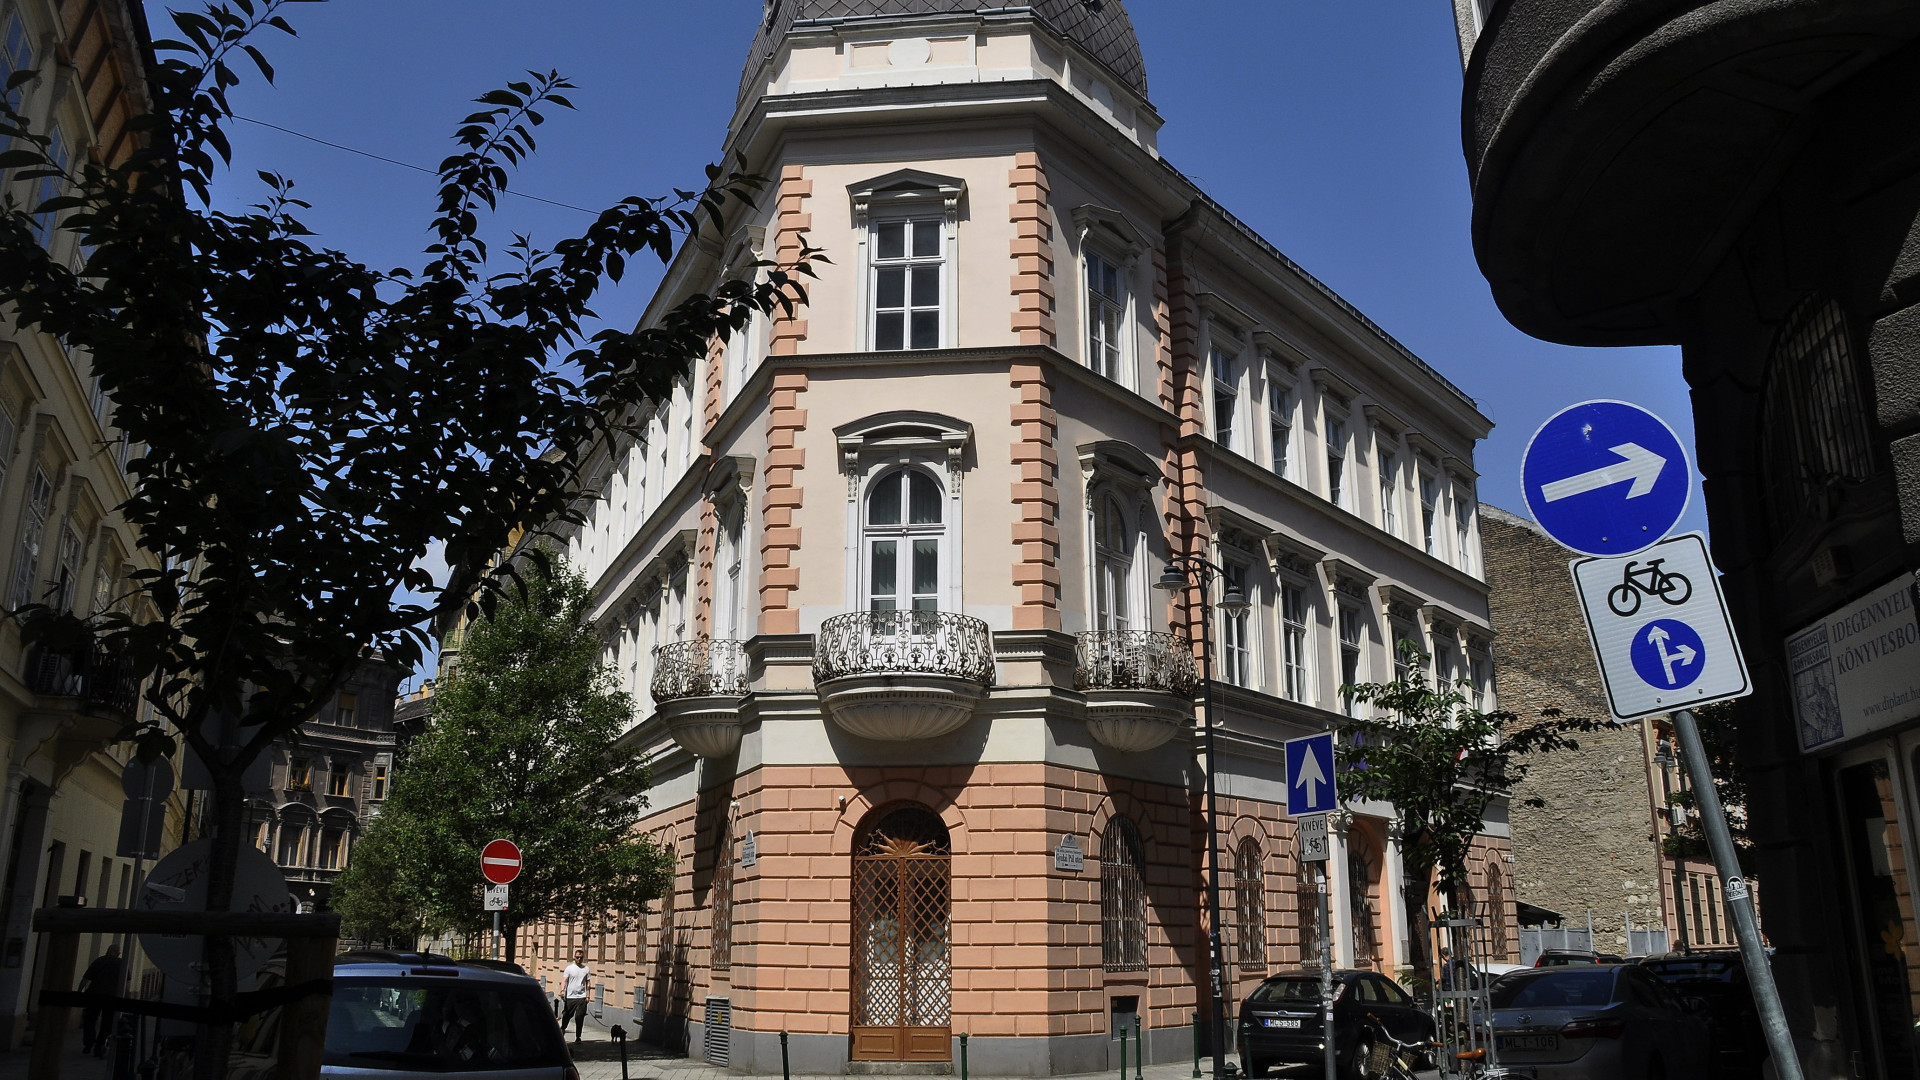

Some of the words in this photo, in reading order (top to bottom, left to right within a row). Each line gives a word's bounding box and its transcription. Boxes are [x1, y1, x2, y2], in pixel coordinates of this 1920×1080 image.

[1837, 622, 1920, 674] KÖNYVESBO
[1301, 818, 1325, 831] KIVÉVE
[1505, 1036, 1554, 1048] MLT-106
